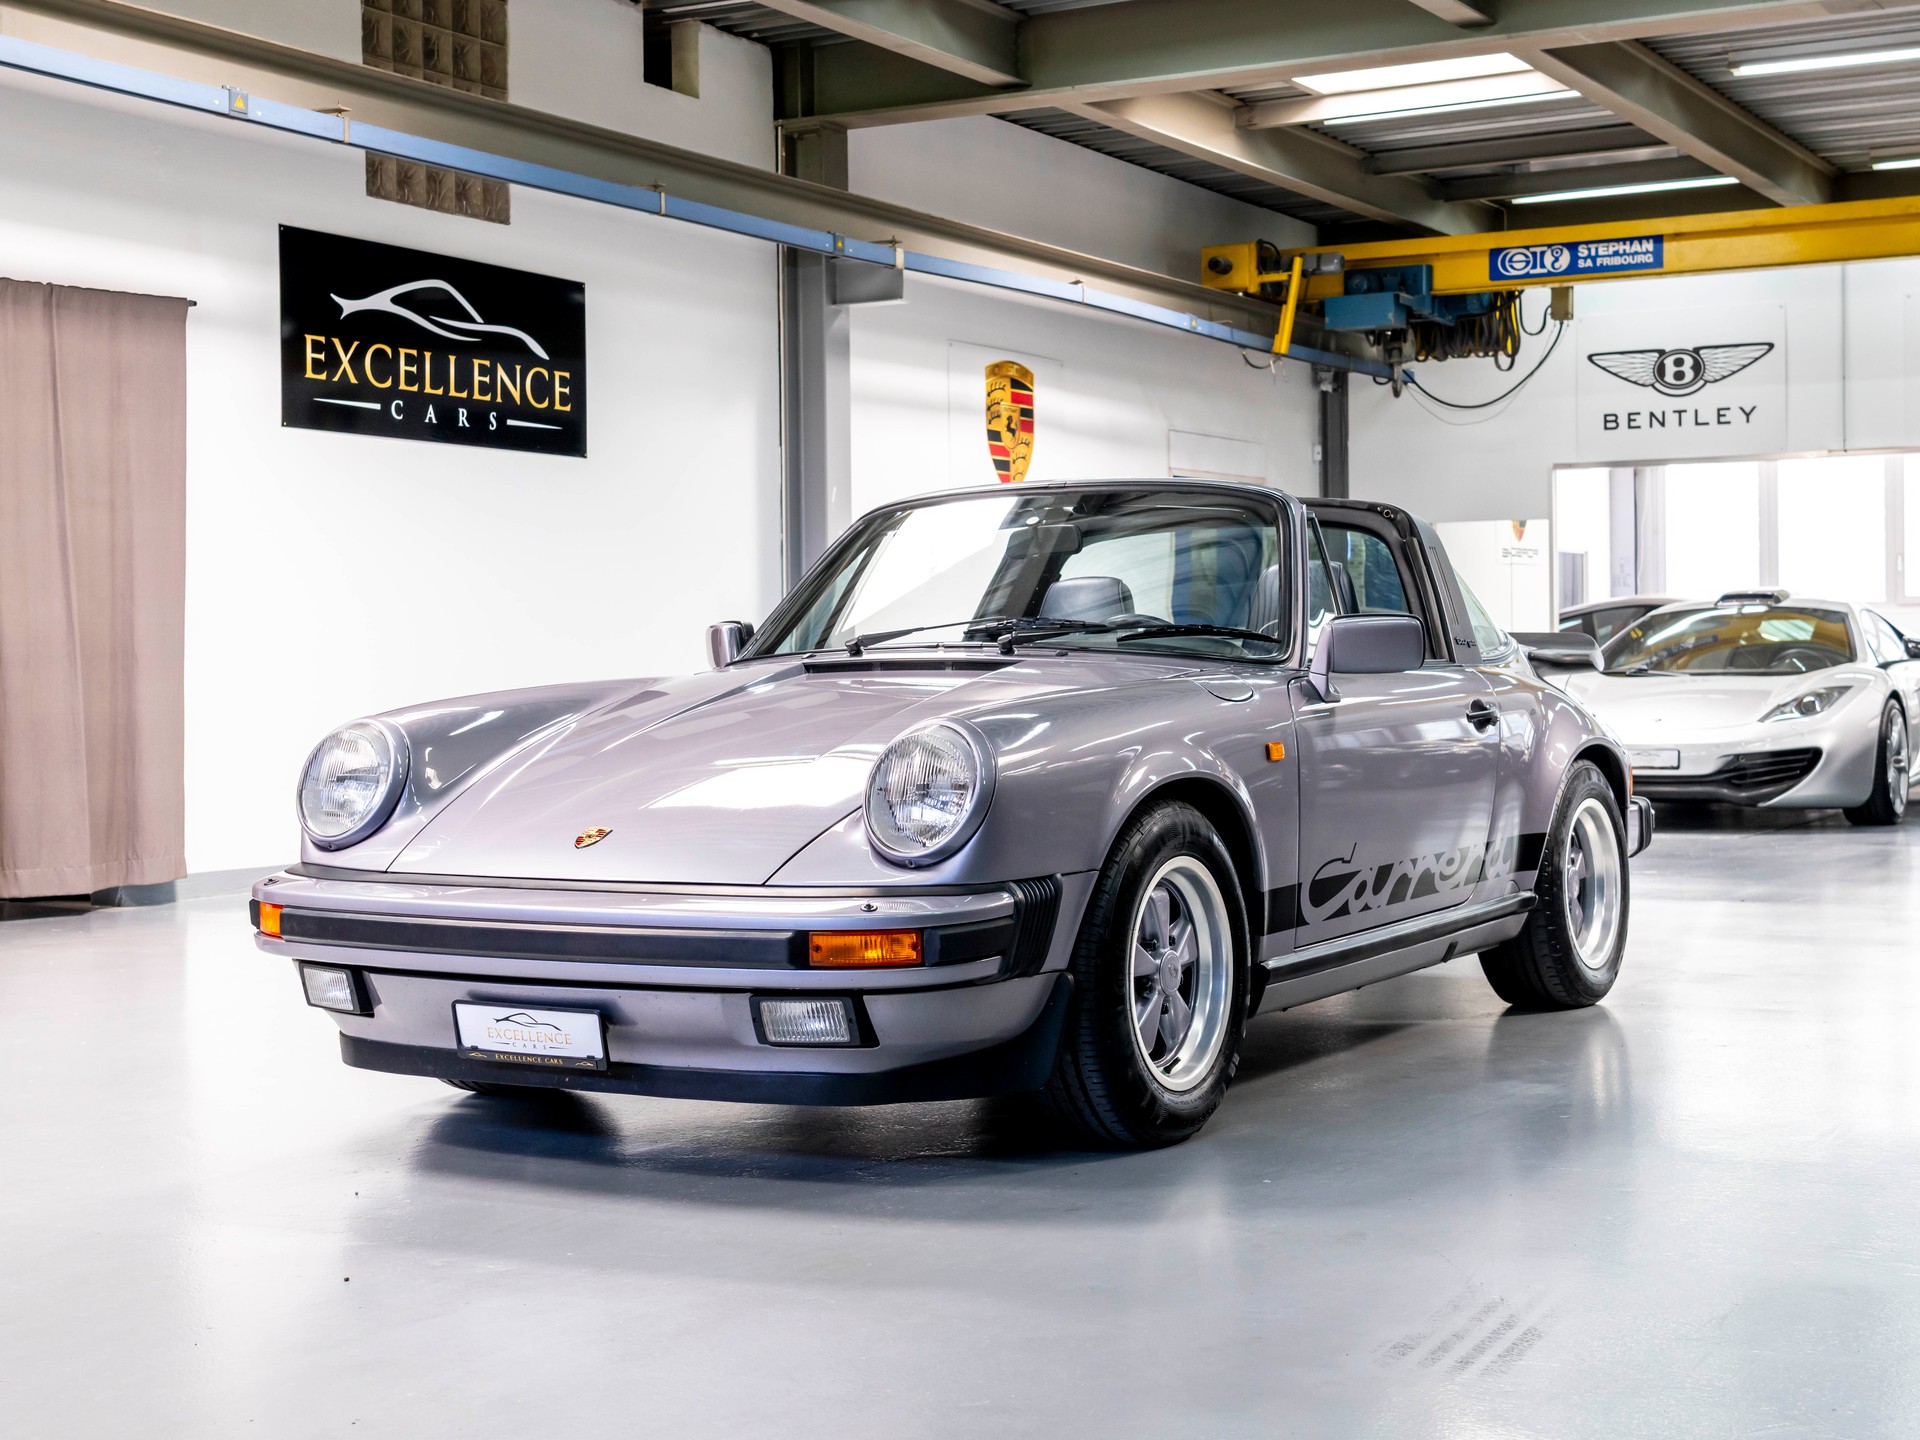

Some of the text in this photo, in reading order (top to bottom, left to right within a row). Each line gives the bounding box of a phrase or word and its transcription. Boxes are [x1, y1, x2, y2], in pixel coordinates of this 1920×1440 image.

[1577, 239, 1654, 257] STEPHAN
[1577, 254, 1654, 268] SA FRIBOURG
[304, 334, 572, 412] EXCELLENCE
[1663, 353, 1695, 386] B
[391, 400, 497, 431] CARS
[1603, 405, 1757, 431] BENTLEY
[1301, 836, 1516, 925] Carrera
[487, 1027, 572, 1045] EXCELLENCE
[512, 1042, 547, 1050] CARS
[495, 1054, 542, 1064] EXCELLENCE
